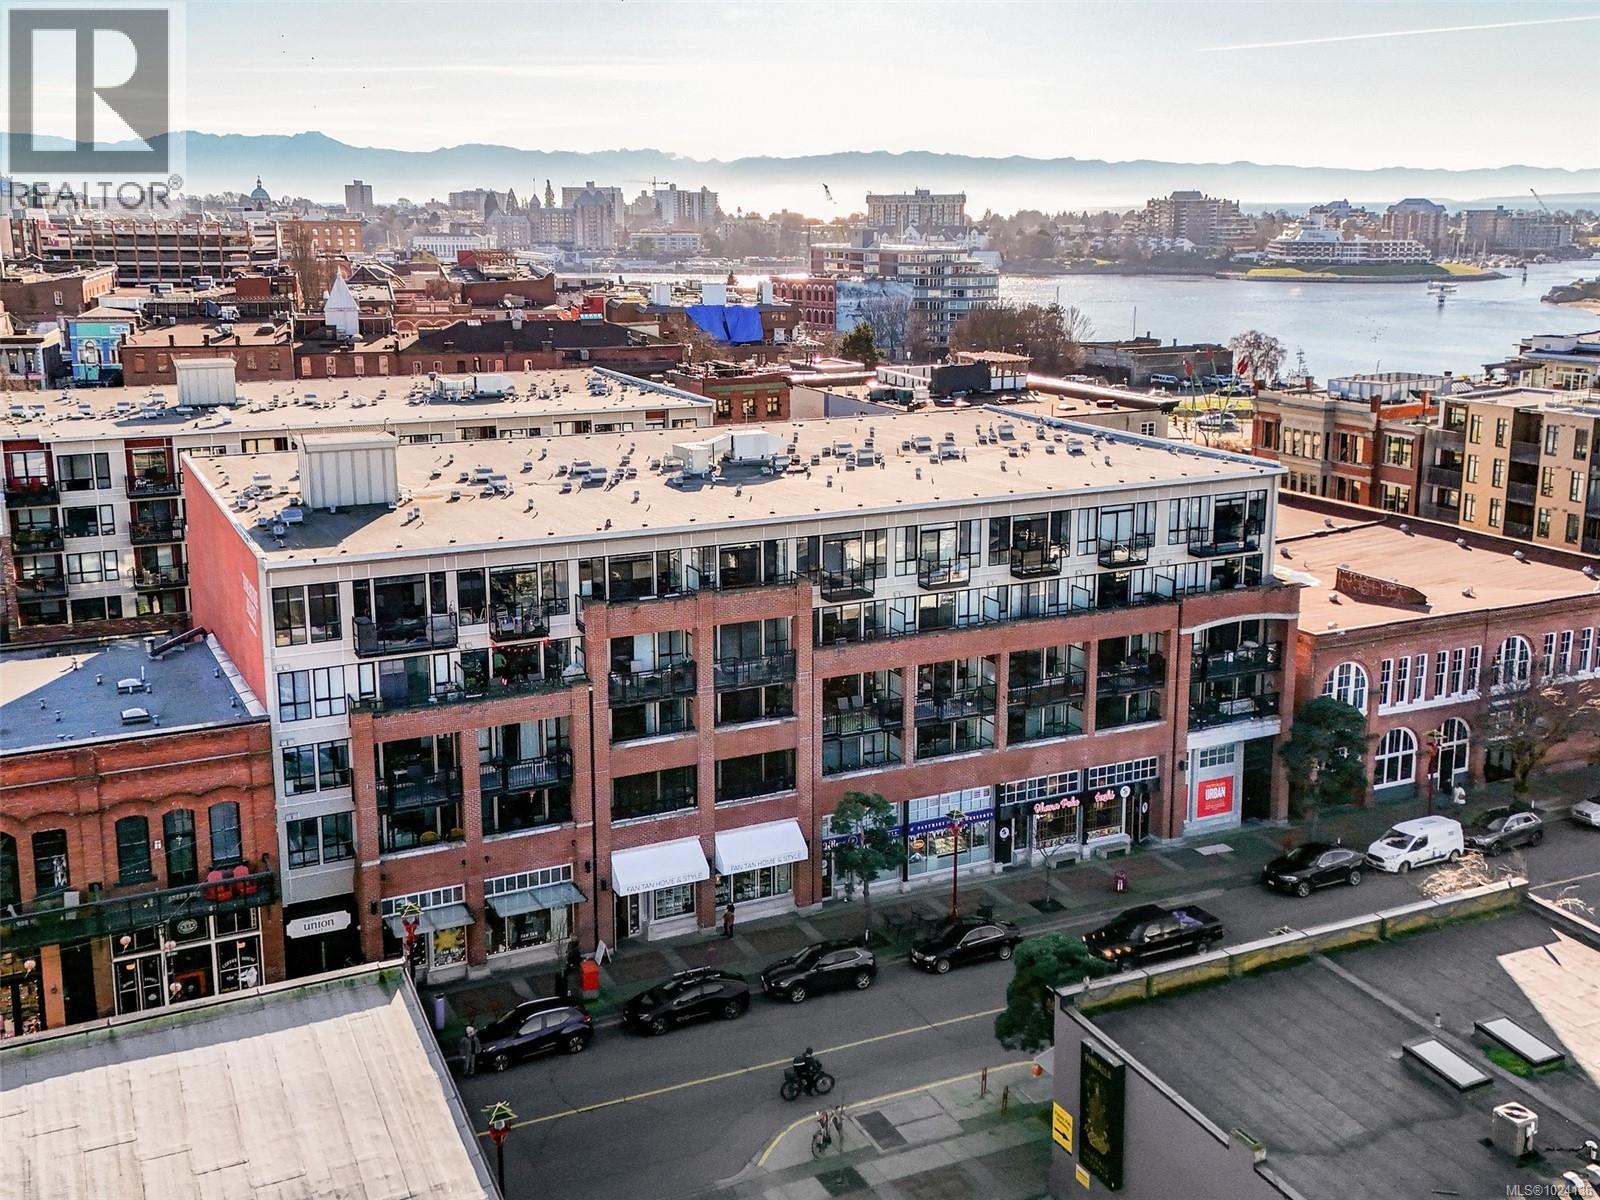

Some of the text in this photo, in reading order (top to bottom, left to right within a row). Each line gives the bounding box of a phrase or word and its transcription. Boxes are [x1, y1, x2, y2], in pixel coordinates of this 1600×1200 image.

[1205, 786, 1226, 801] URBAN
[730, 864, 743, 872] FAN
[758, 857, 775, 866] HOME
[782, 852, 802, 861] STYLE
[626, 885, 641, 893] FAN
[655, 878, 675, 887] HOME
[683, 872, 703, 881] STYLE
[303, 918, 335, 931] union
